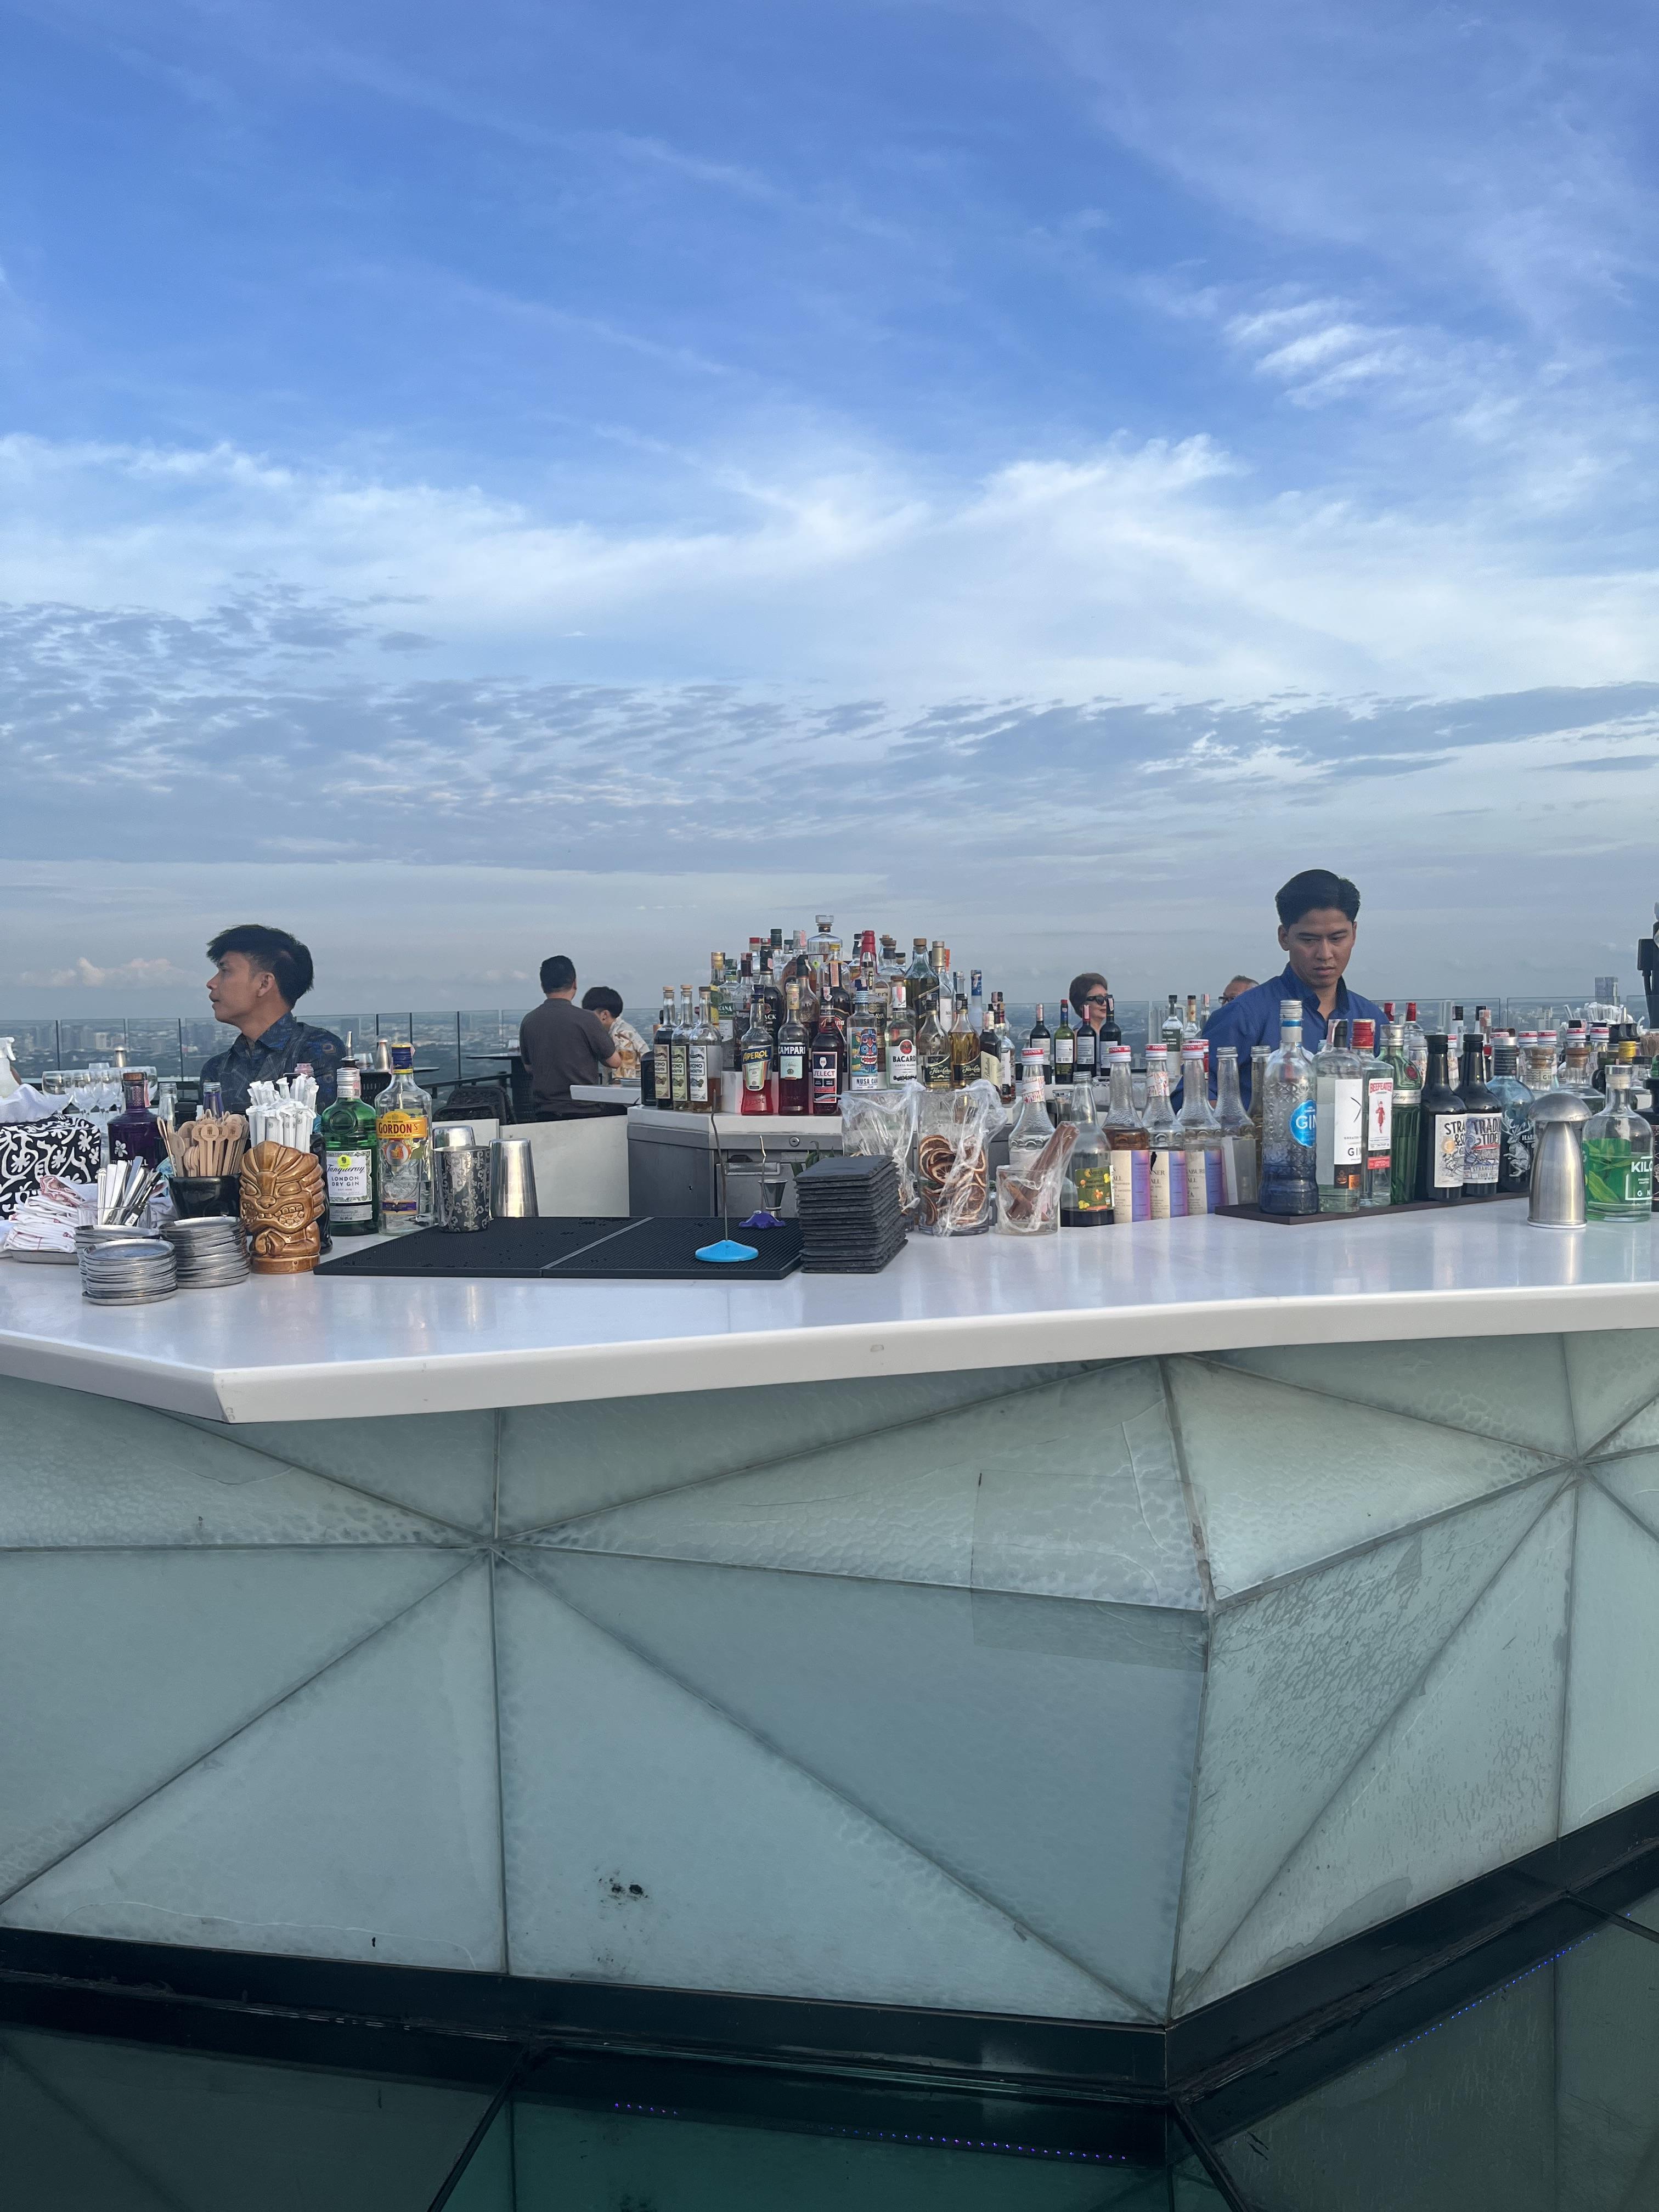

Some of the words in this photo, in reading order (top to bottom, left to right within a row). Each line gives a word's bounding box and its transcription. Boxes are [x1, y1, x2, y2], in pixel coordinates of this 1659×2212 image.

[743, 1050, 768, 1061] APEROL
[778, 1046, 806, 1054] CAMPARI
[1369, 1082, 1392, 1093] BEEFEATER
[327, 1164, 365, 1175] Tanqueray
